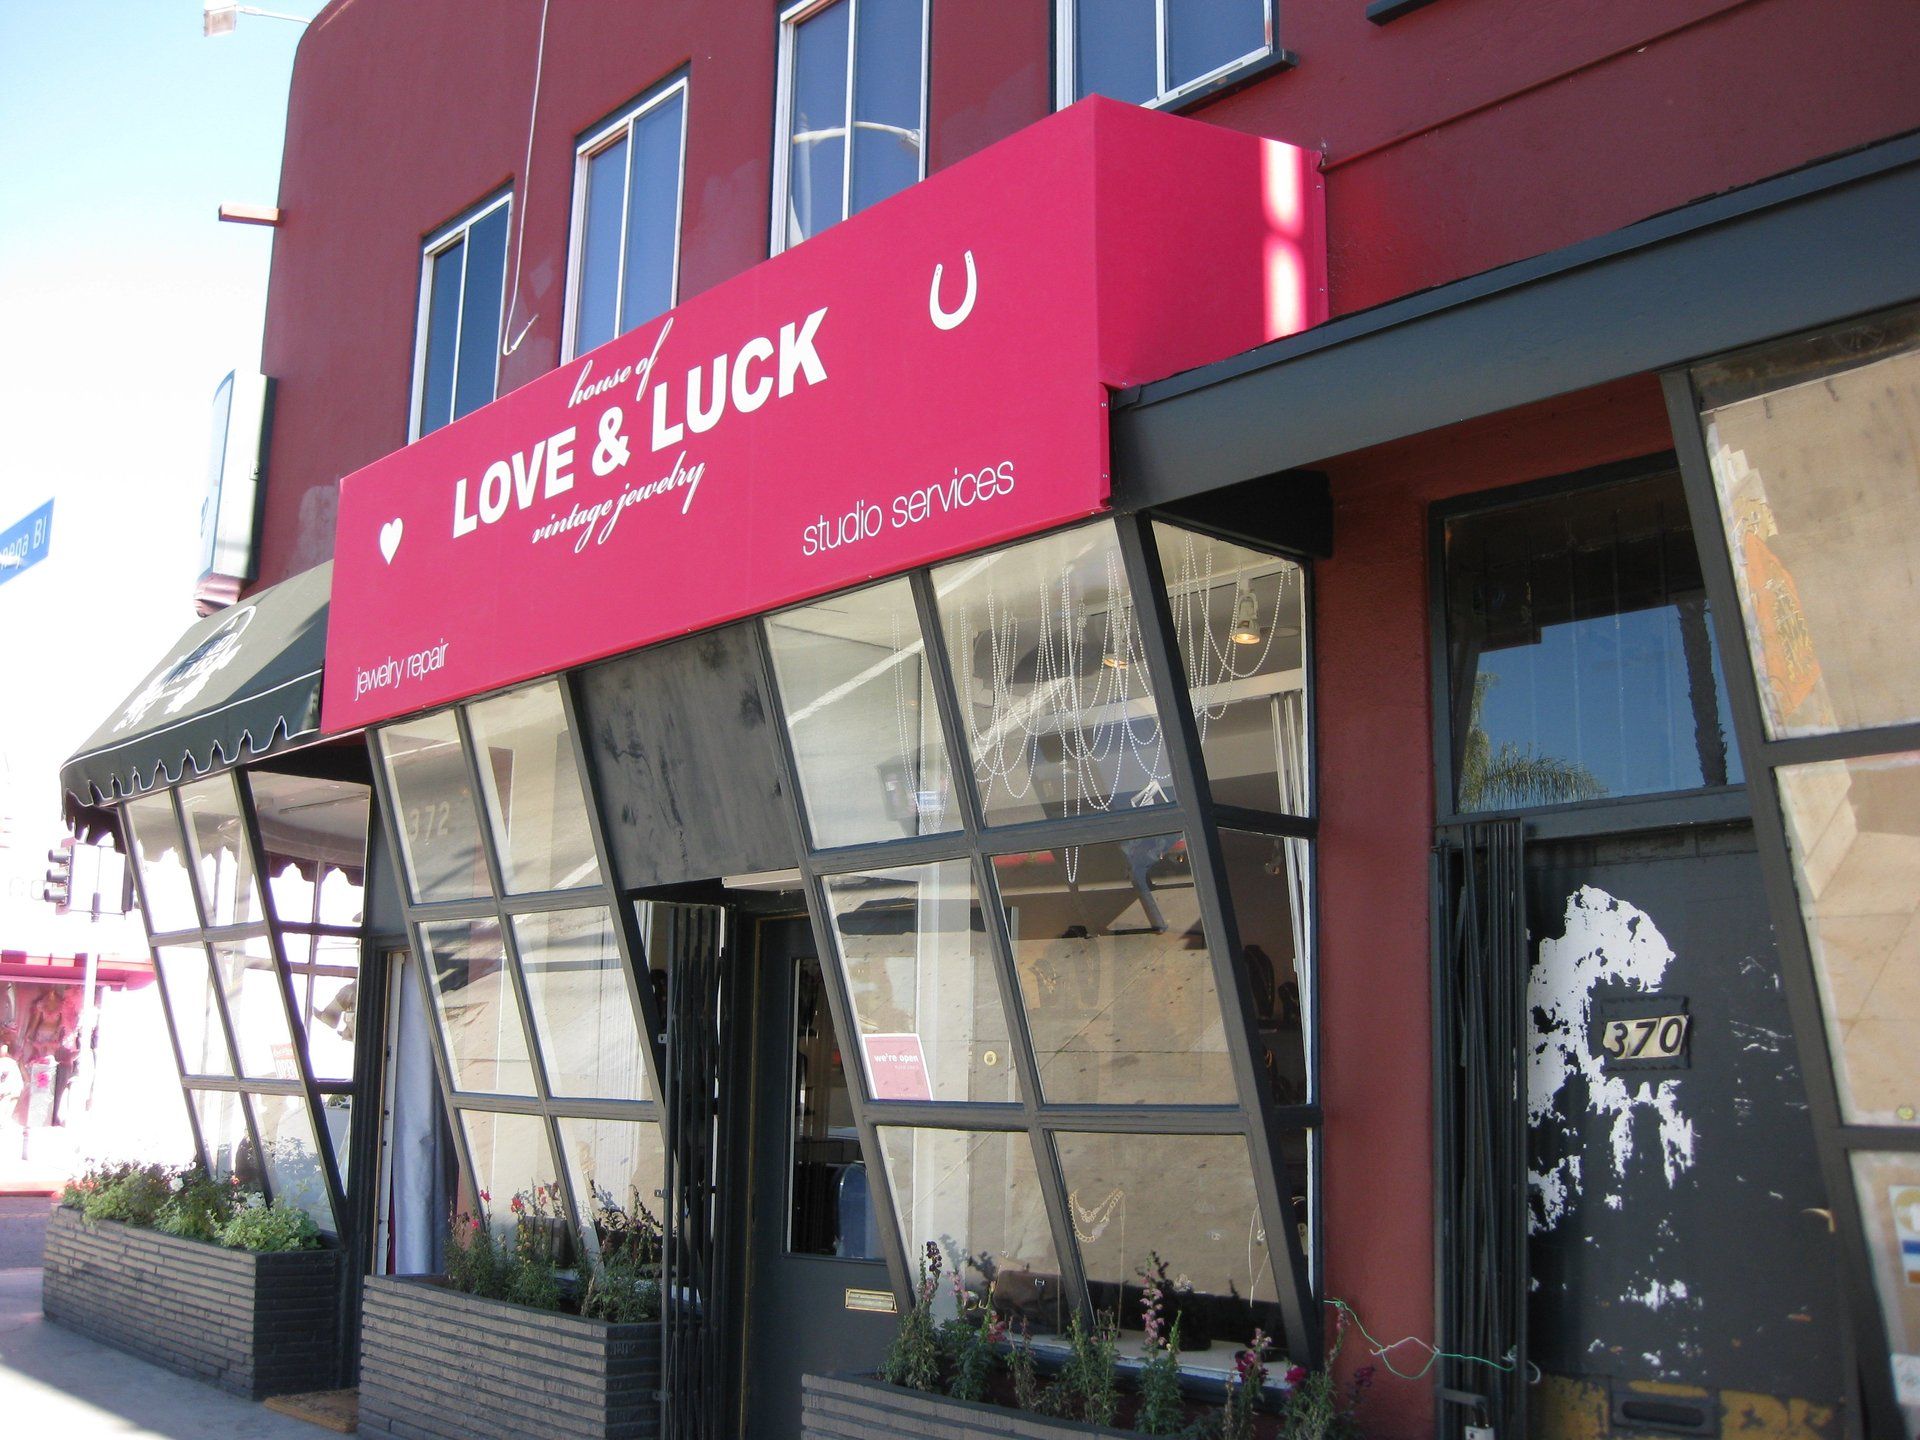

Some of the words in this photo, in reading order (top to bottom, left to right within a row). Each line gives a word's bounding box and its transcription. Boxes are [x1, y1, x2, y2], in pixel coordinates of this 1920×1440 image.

[568, 360, 630, 408] house
[635, 317, 674, 401] of
[453, 426, 576, 539] LOVE
[591, 406, 631, 477] &
[651, 307, 828, 452] LUCK
[531, 493, 613, 553] vintage
[597, 450, 705, 544] jewelry
[802, 499, 883, 556] studio
[891, 461, 1015, 528] services
[354, 656, 405, 702] jewelry
[406, 638, 449, 680] repair
[408, 801, 450, 844] 372
[873, 1053, 897, 1062] we're
[899, 1054, 919, 1063] open
[1608, 1018, 1683, 1057] 370
